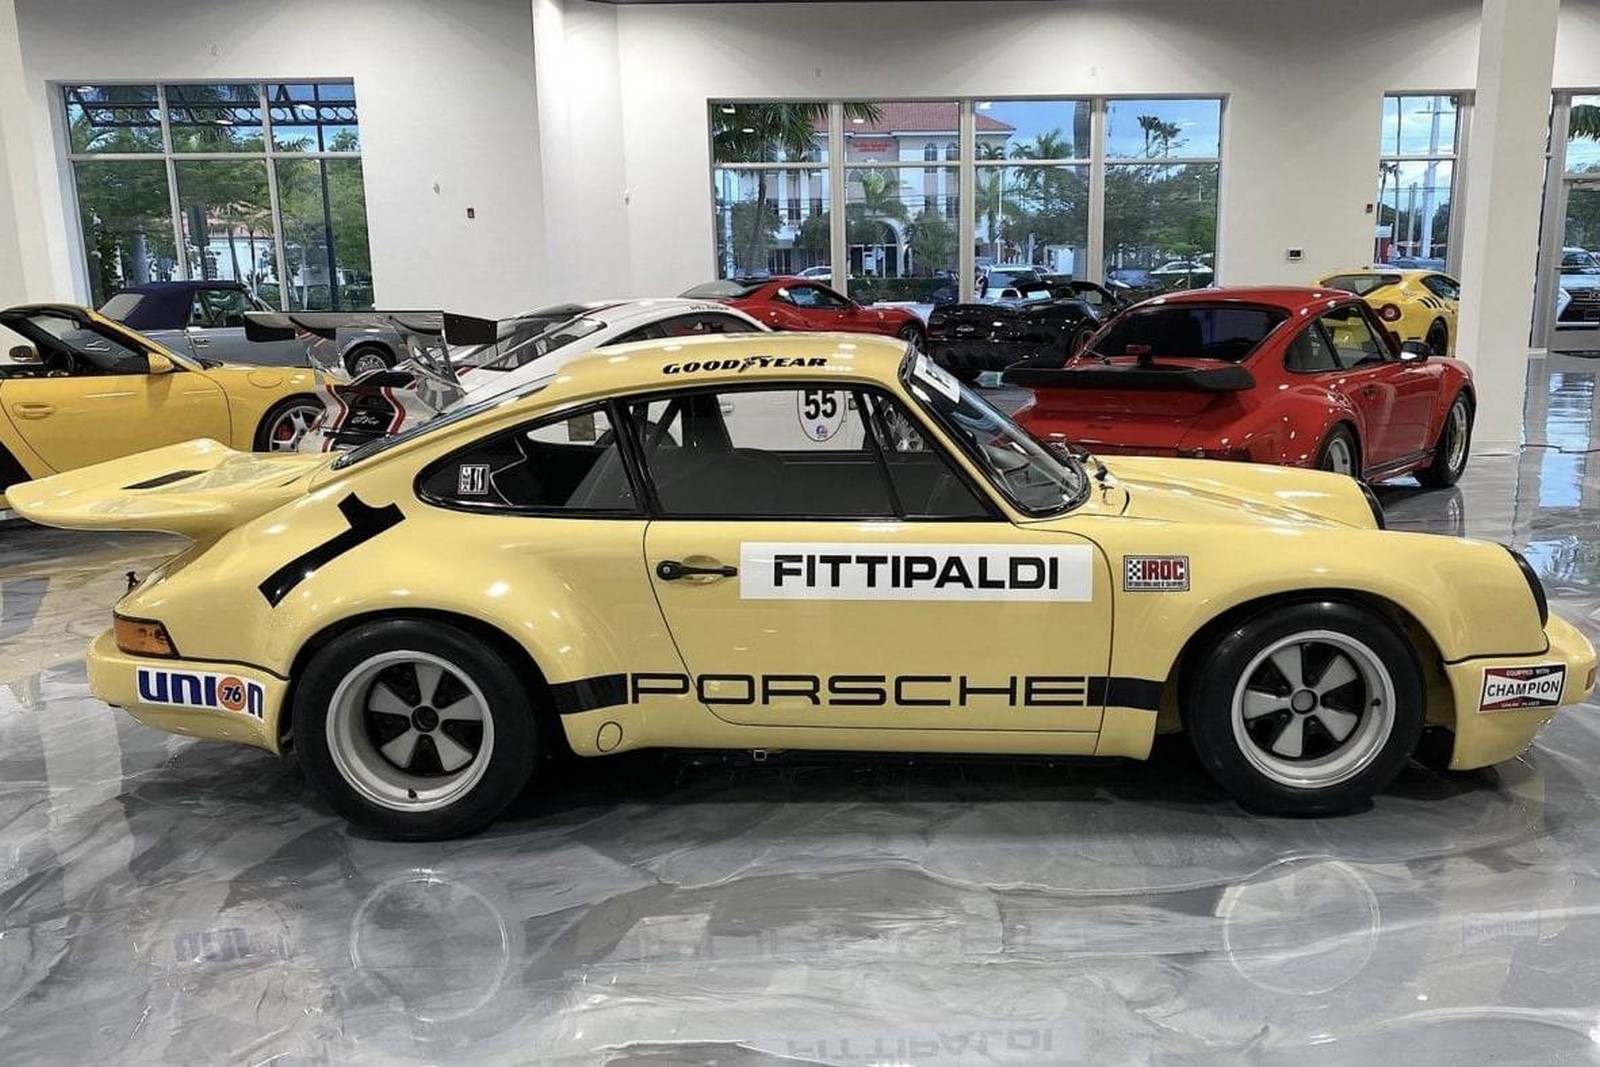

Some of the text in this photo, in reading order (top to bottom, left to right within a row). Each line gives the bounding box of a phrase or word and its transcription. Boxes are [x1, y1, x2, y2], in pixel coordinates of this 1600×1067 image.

[663, 355, 827, 374] GOODYEAR
[804, 389, 837, 420] 55
[258, 491, 406, 609] 1
[773, 554, 1059, 590] FITTIPALDI
[1142, 560, 1184, 580] IROC
[223, 686, 241, 703] 76
[631, 673, 1085, 707] PORSCHE
[1487, 680, 1560, 697] CHAMPION
